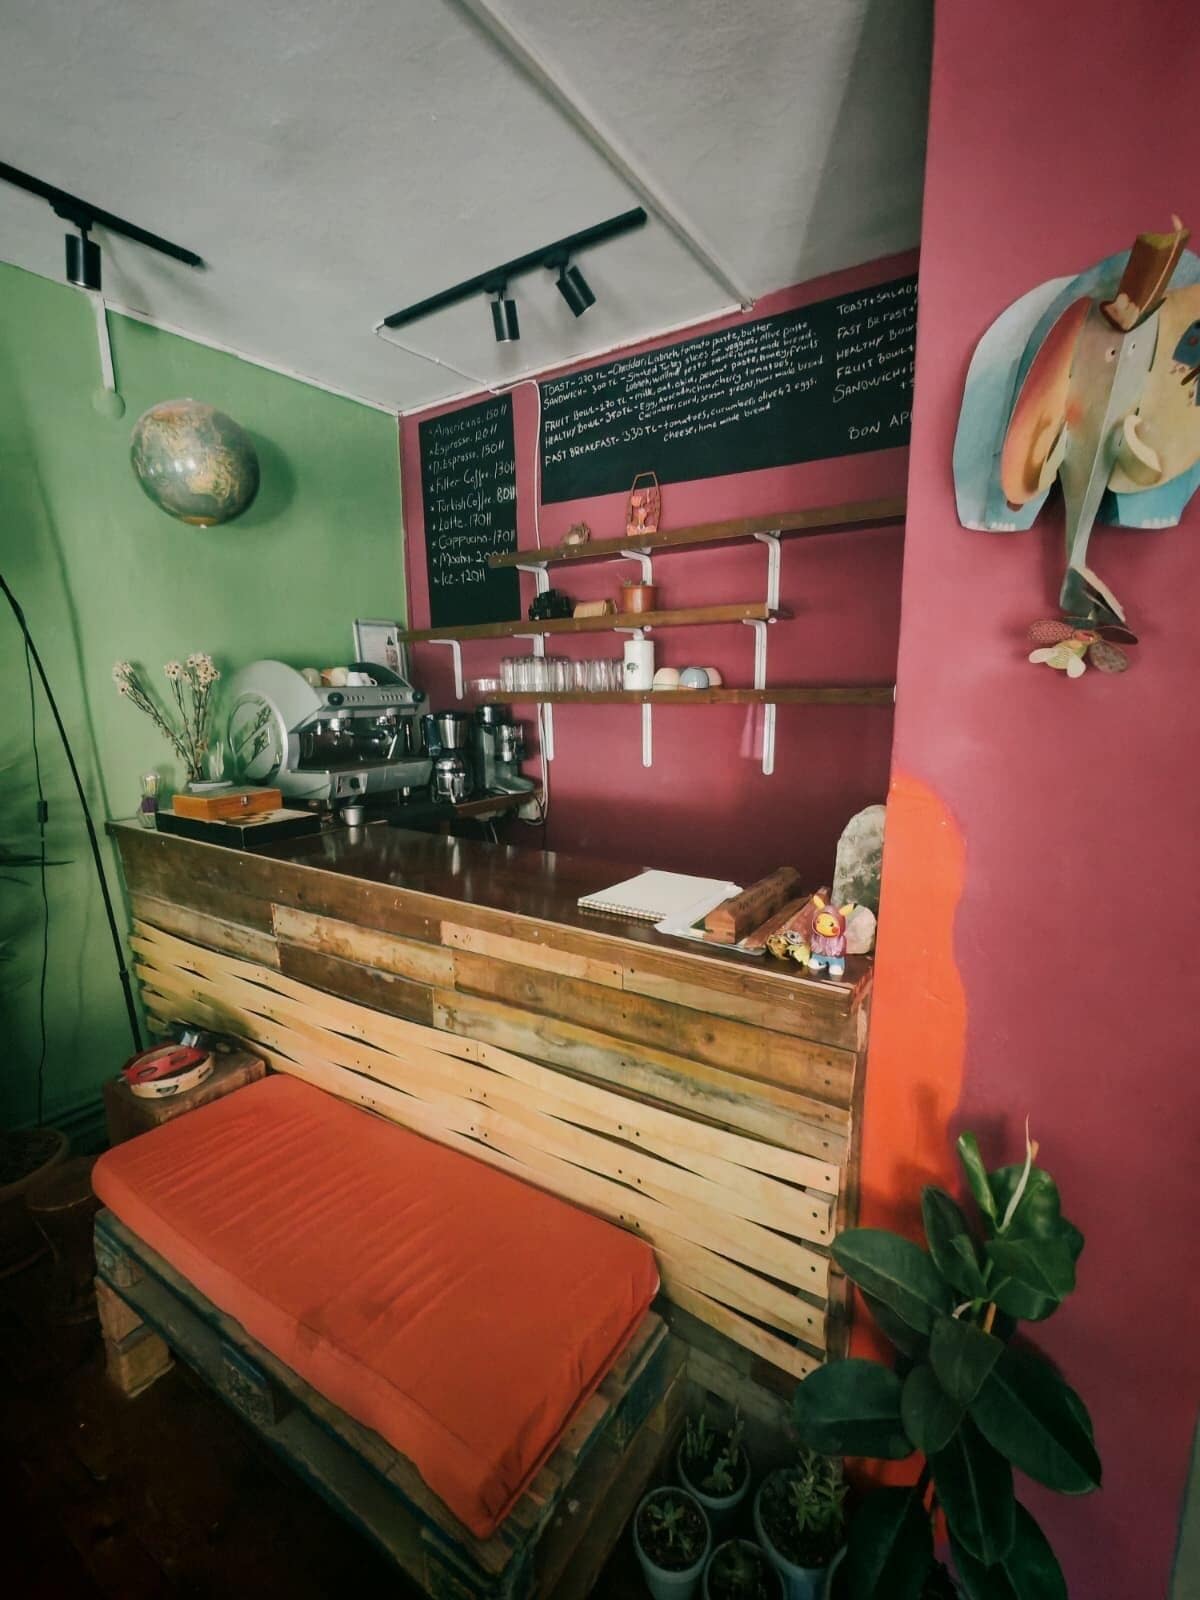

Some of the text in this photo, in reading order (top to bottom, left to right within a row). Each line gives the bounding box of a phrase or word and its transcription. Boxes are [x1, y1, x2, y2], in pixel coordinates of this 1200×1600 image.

[741, 322, 773, 338] butter
[837, 323, 861, 340] FAST
[836, 325, 914, 360] HEALTHY BOW
[836, 358, 873, 380] FRUIT
[832, 367, 900, 404] SANDWICH
[544, 416, 569, 433] FRUIT
[848, 411, 913, 440] BON AP
[544, 426, 576, 449] HEALTHY
[544, 450, 566, 468] FAST
